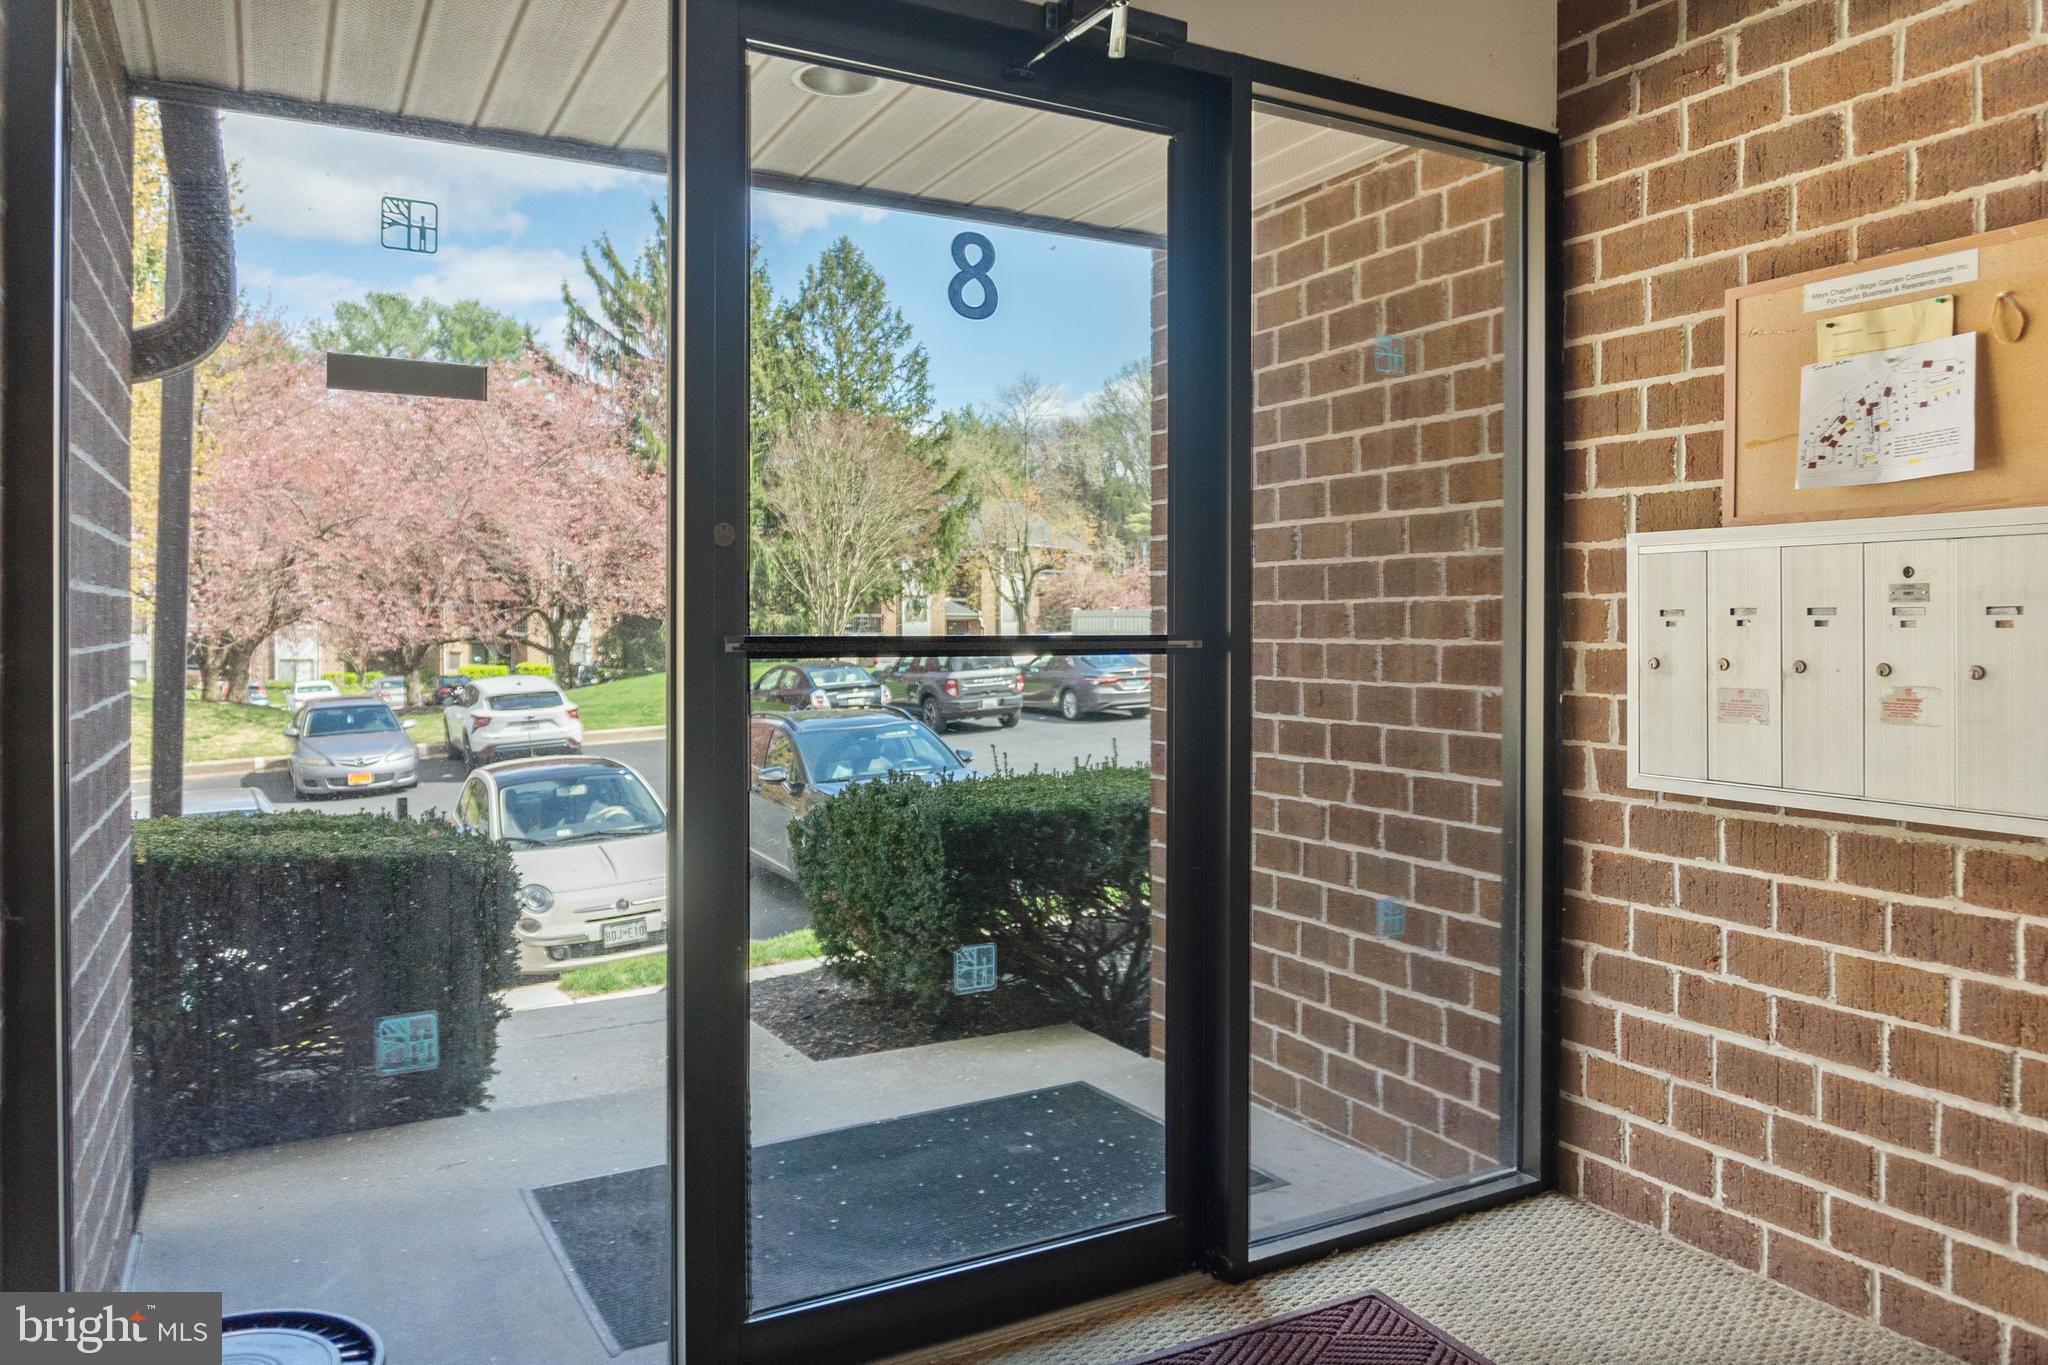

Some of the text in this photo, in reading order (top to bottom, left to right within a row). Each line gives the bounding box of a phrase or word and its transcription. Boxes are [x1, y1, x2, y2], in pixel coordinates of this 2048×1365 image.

[948, 231, 998, 320] 8
[1811, 292, 1829, 300] Mays
[1830, 287, 1853, 297] Chapel
[1855, 282, 1877, 291] Village
[1878, 277, 1904, 287] Garden
[1905, 266, 1954, 280] Condominium
[1839, 293, 1861, 303] Condo
[1862, 287, 1892, 298] Business
[1901, 279, 1937, 290] Residents
[1937, 275, 1953, 284] only
